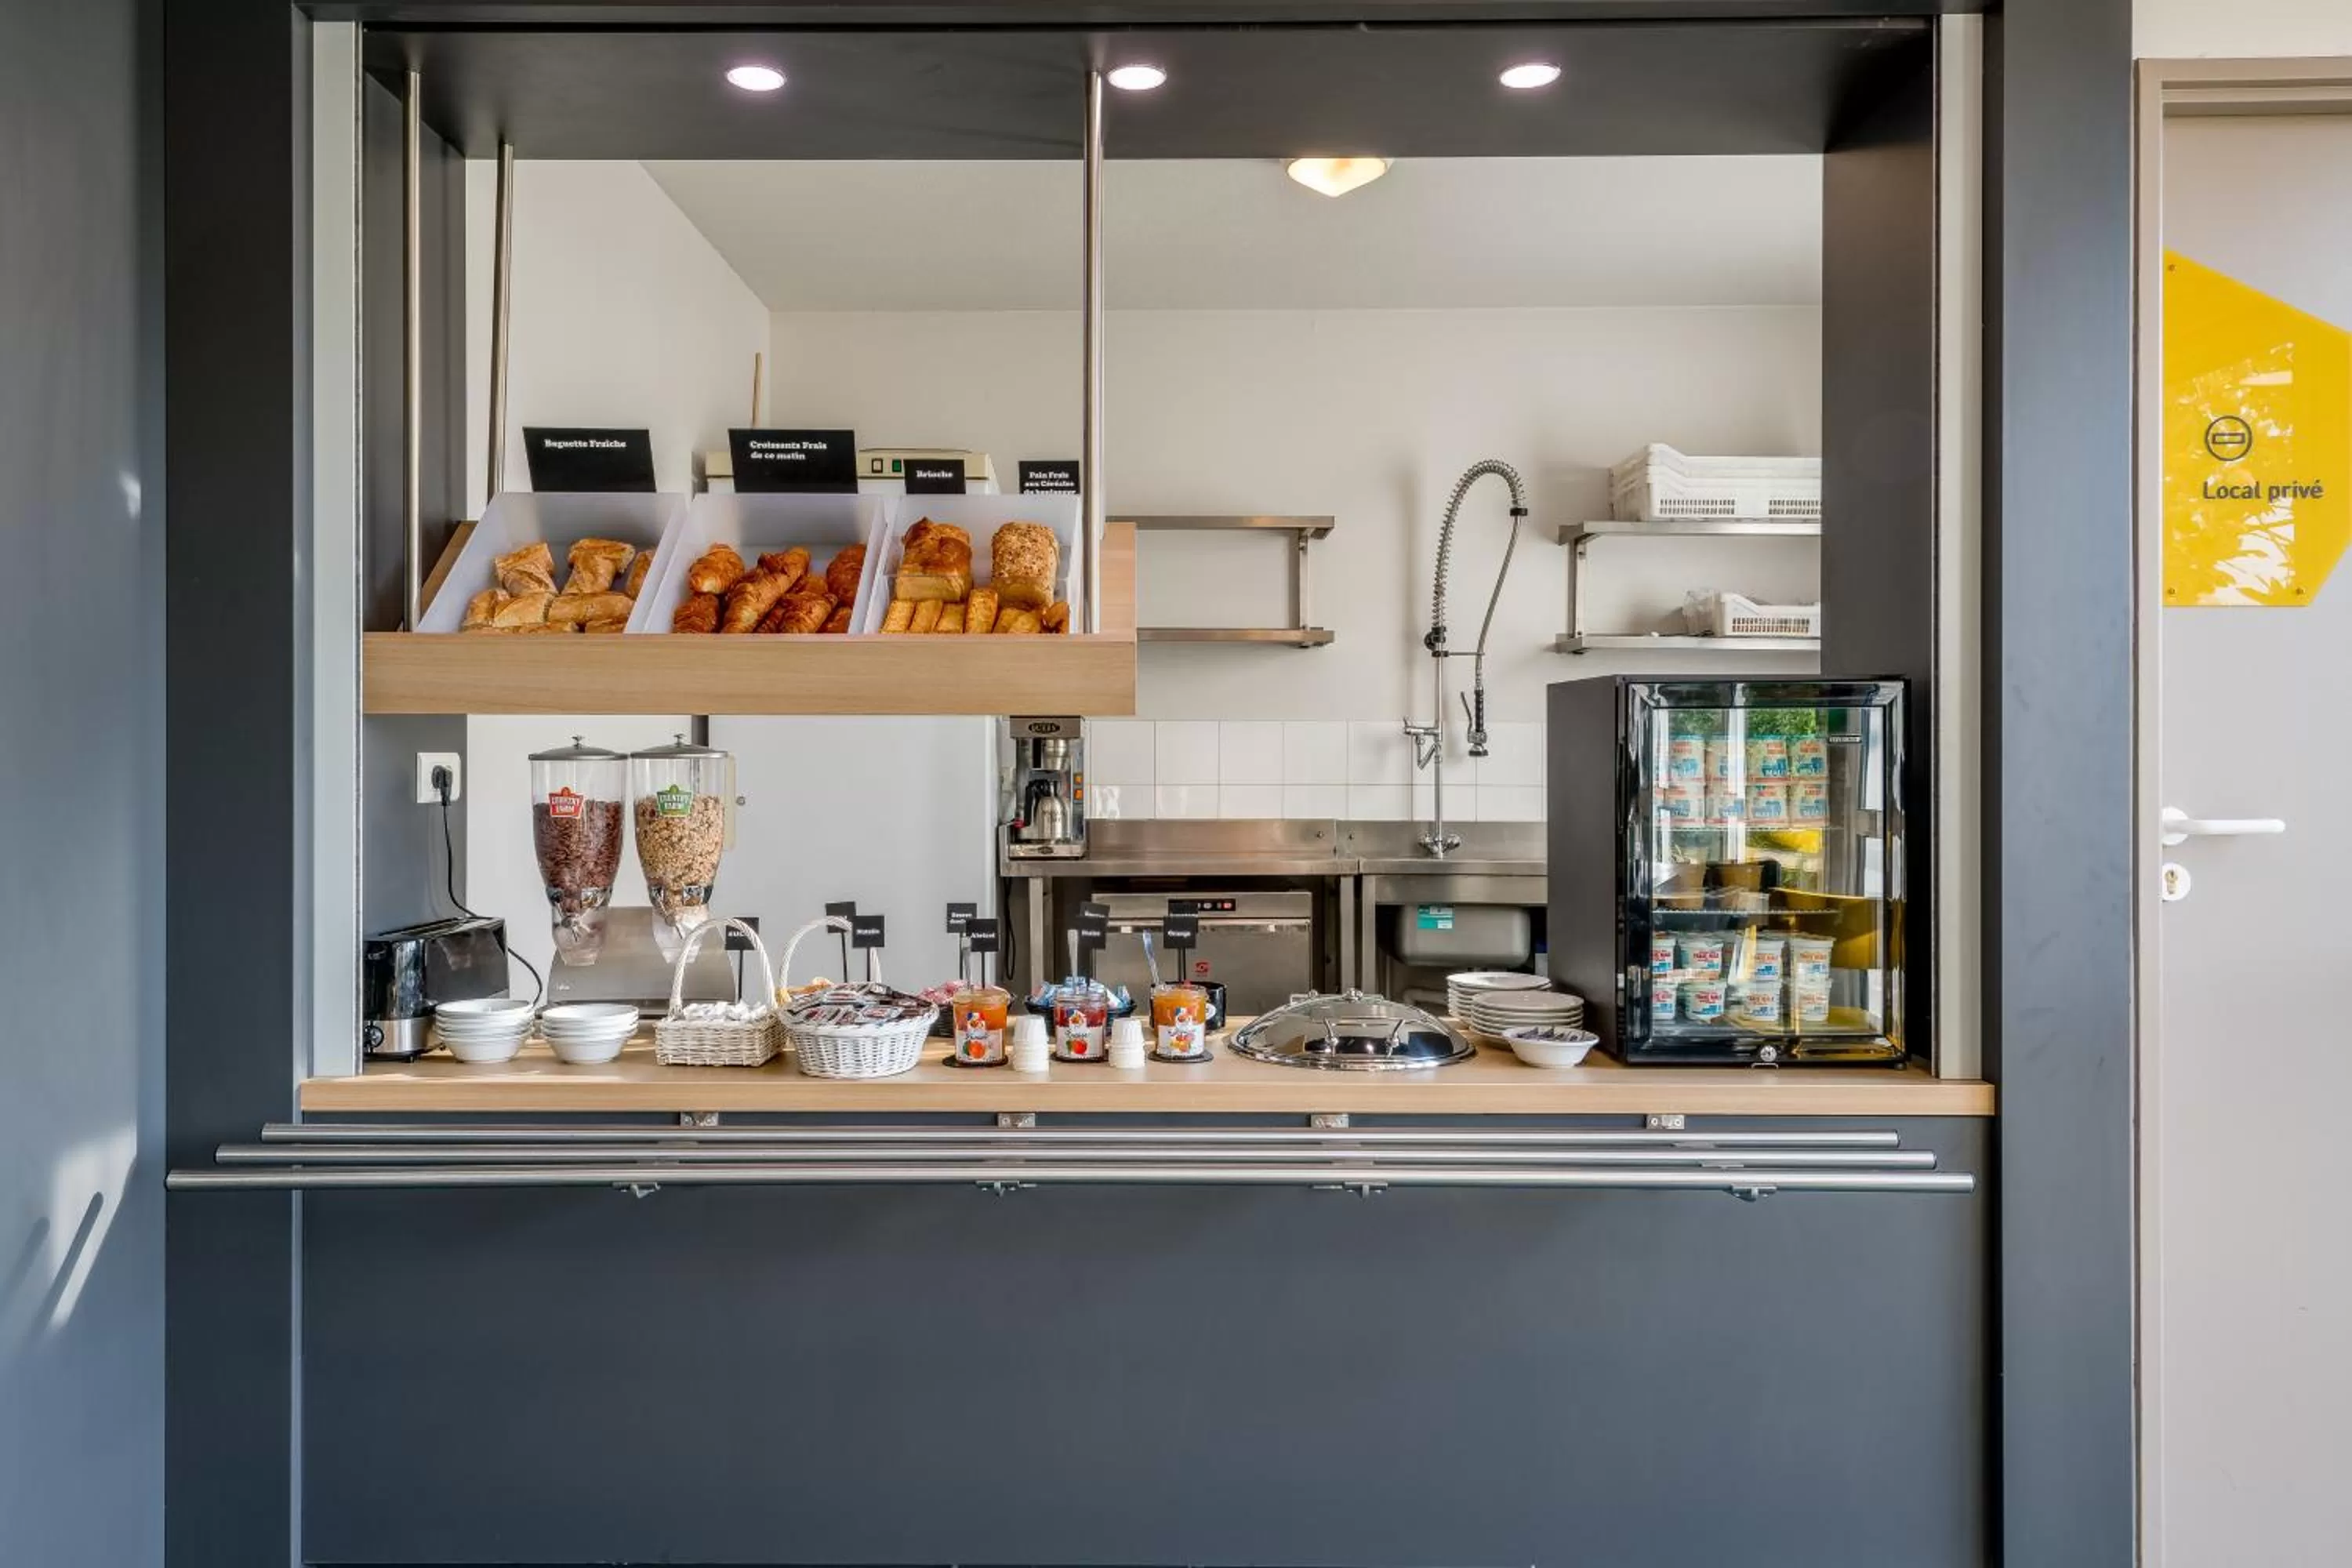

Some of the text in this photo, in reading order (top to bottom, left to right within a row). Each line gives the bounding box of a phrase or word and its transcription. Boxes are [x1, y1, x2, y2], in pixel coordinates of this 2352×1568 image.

[750, 441, 800, 449] Croissants
[2203, 480, 2324, 503] Local privé
